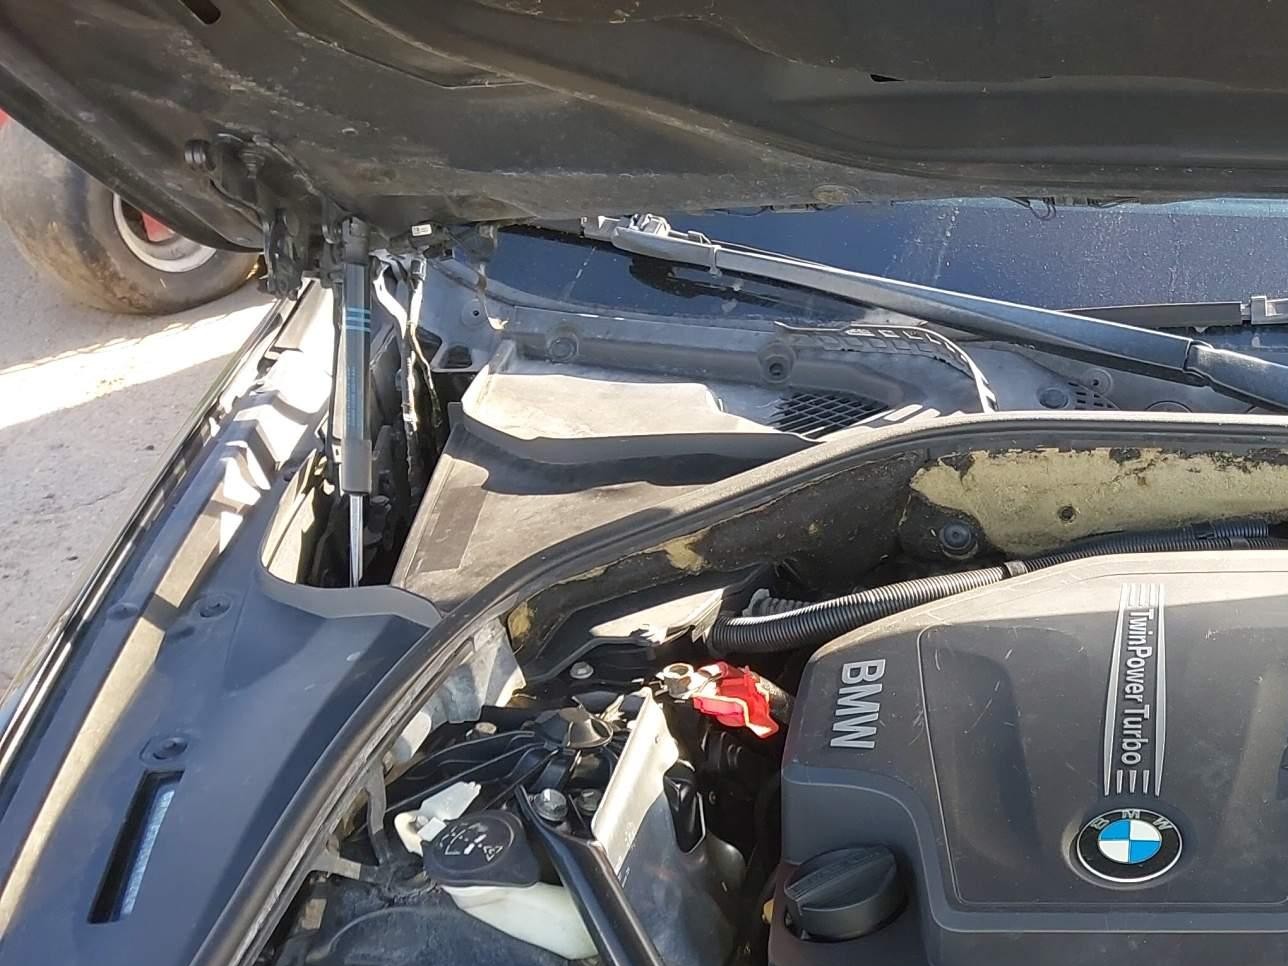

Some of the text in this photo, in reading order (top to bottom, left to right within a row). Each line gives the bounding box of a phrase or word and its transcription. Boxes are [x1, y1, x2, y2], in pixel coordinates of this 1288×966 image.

[830, 659, 886, 749] BMW
[1122, 608, 1154, 766] TwinPower Turbo
[1090, 808, 1172, 831] BMW
